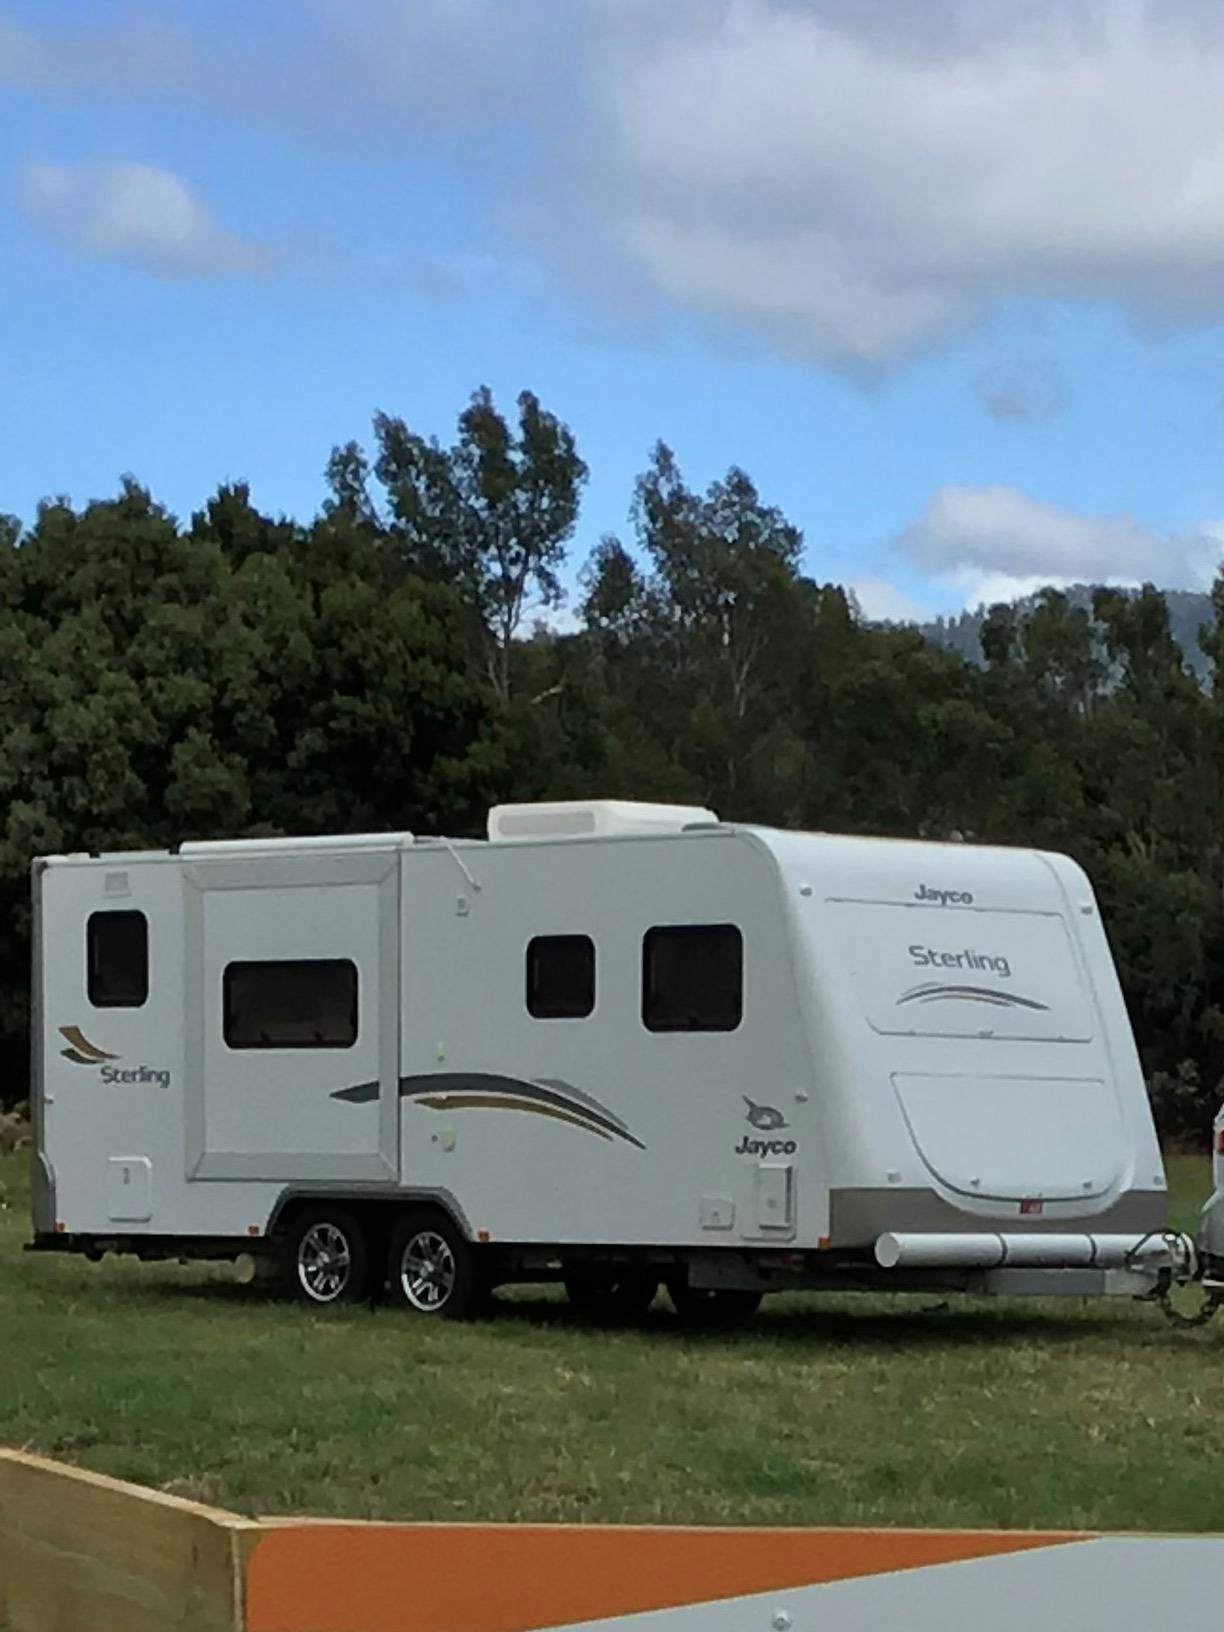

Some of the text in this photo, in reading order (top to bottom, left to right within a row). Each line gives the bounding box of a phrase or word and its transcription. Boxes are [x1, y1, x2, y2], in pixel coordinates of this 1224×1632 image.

[914, 883, 974, 906] Jayco
[908, 945, 1012, 978] Sterling
[100, 1065, 171, 1089] Sterling
[734, 1135, 797, 1159] Jayco
